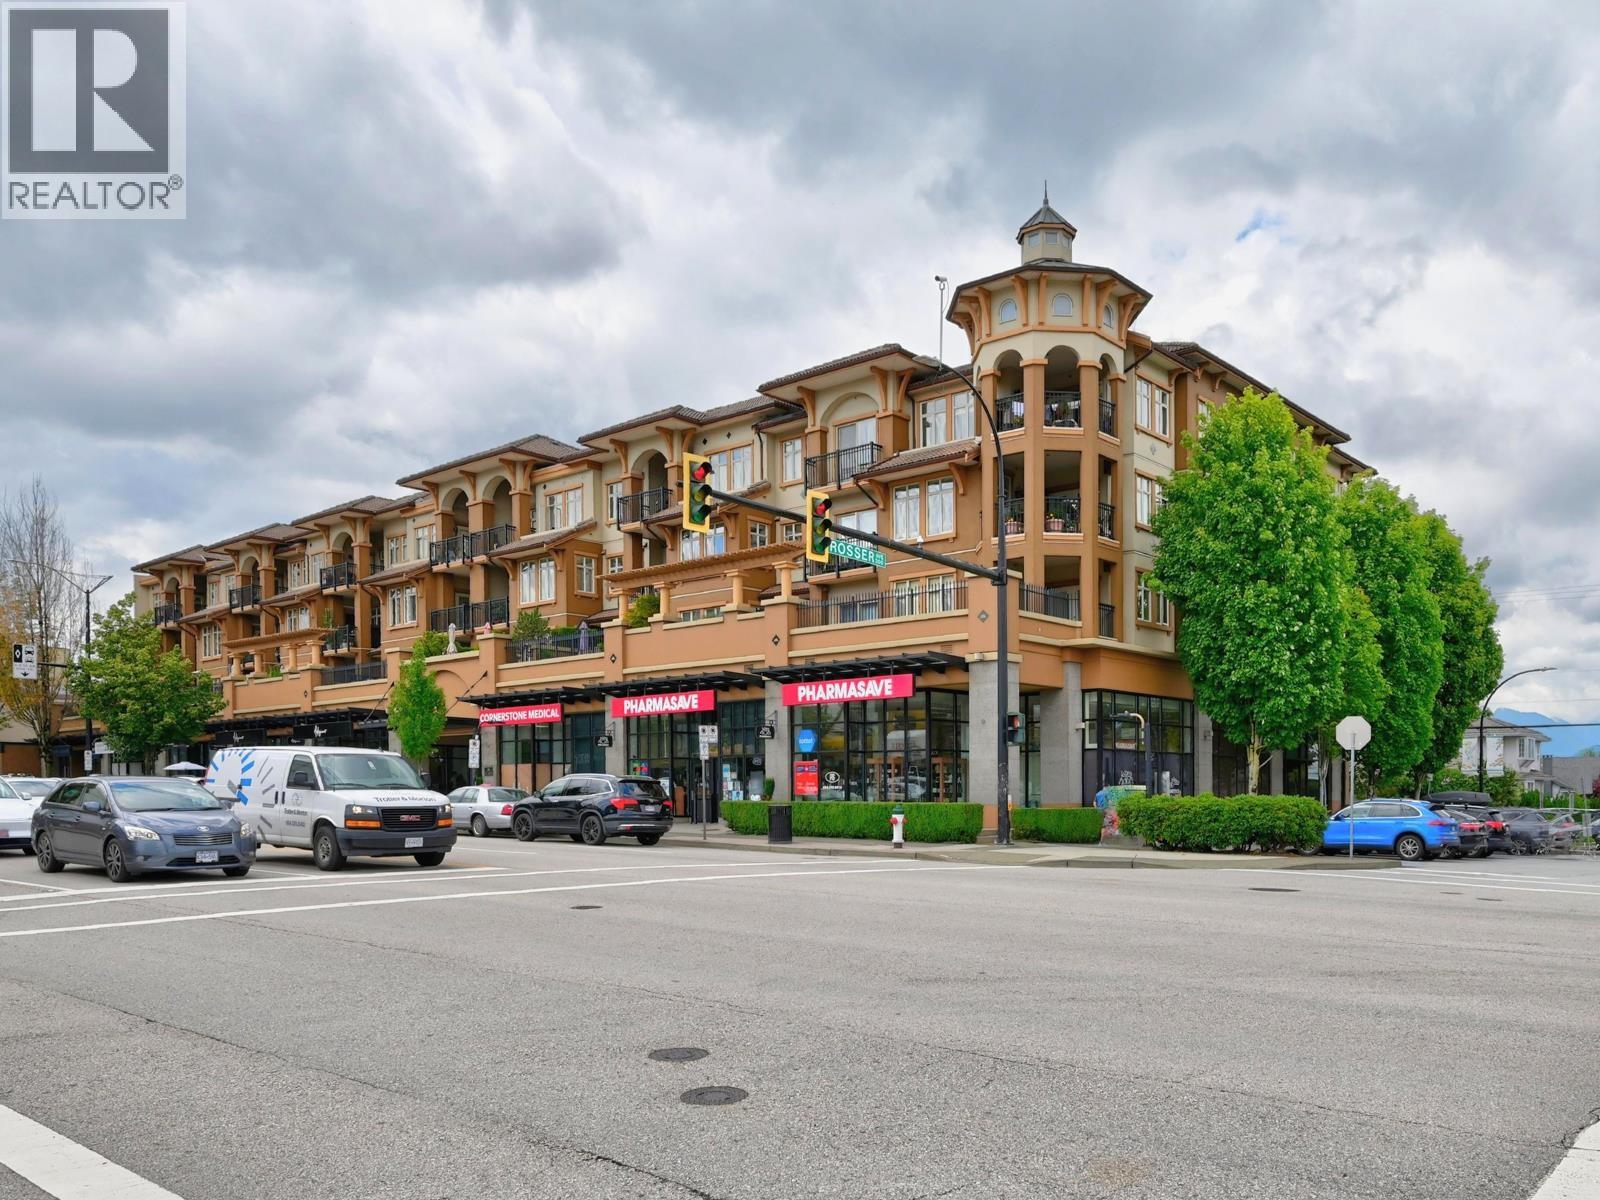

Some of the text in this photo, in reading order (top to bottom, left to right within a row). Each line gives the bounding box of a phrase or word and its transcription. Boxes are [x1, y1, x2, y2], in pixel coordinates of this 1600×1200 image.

[829, 540, 875, 563] ROSSER
[797, 678, 893, 702] PHARMASAVE
[623, 693, 699, 715] PHARMASAVE
[480, 708, 560, 723] CORNERSTONE MEDICAL
[400, 814, 421, 822] GMC
